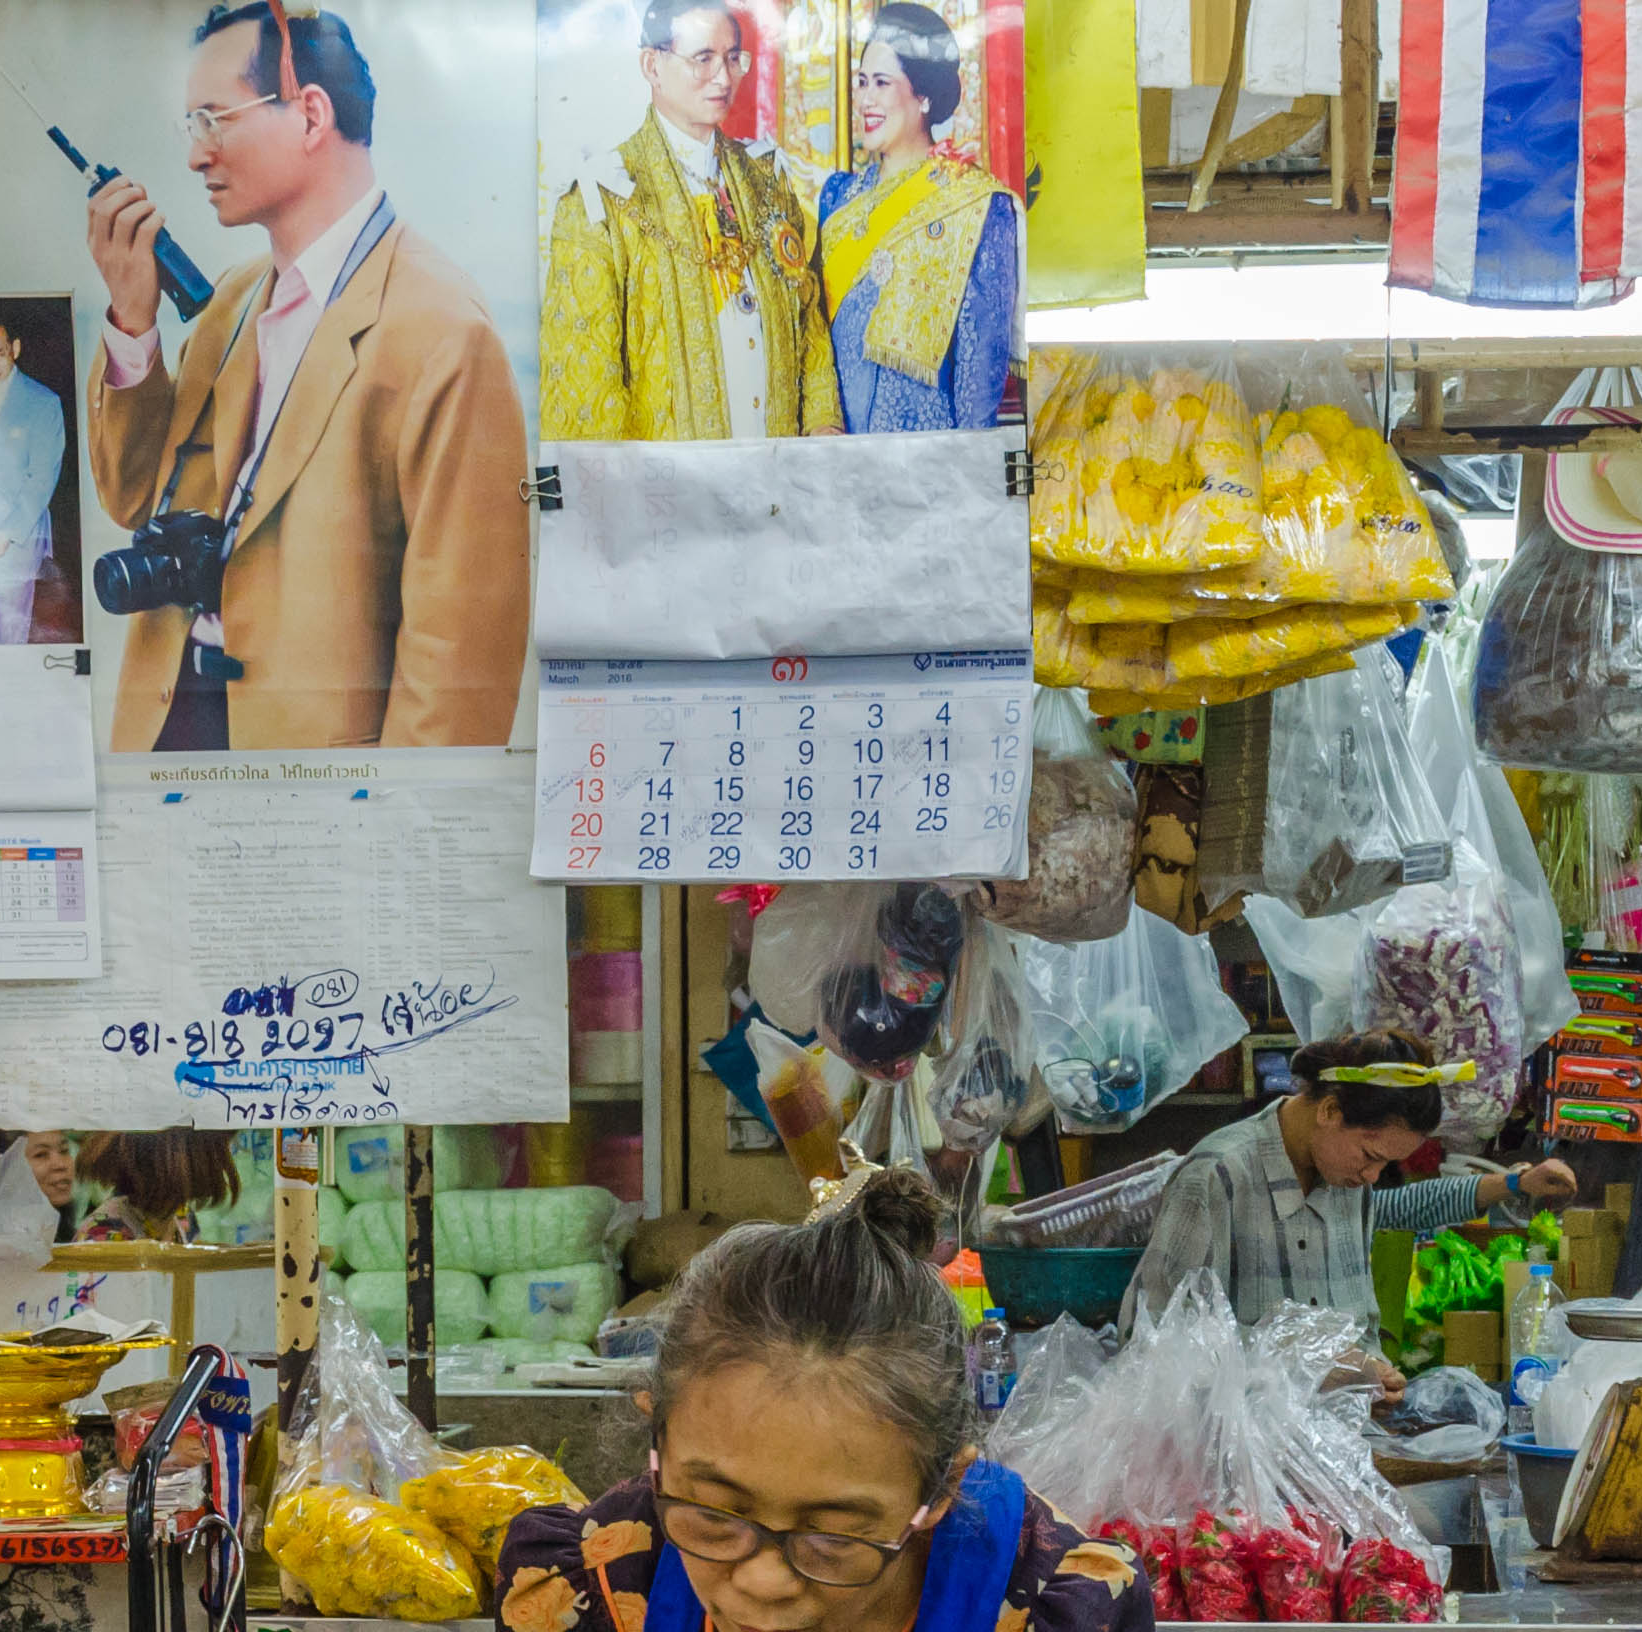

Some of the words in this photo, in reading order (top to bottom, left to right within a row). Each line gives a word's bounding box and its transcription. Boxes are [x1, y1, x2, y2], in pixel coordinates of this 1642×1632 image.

[548, 674, 579, 685] March
[607, 673, 633, 684] 2016
[771, 656, 808, 682] ๓
[731, 706, 741, 730] 1
[799, 705, 815, 730] 2
[867, 703, 884, 729] 3
[935, 701, 952, 726] 4
[1005, 700, 1021, 724] 5
[589, 743, 606, 768] 6
[659, 742, 676, 766] 7
[728, 741, 745, 766] 8
[798, 740, 814, 765] 9
[853, 738, 884, 764] 10
[923, 736, 949, 761] 11
[991, 735, 1020, 759] 12
[574, 778, 604, 803] 13
[644, 777, 674, 801] 14
[714, 777, 744, 802] 15
[783, 776, 813, 801] 16
[853, 774, 883, 799] 17
[922, 773, 950, 797] 18
[990, 770, 1016, 795] 19
[570, 812, 603, 837] 20
[639, 811, 669, 836] 21
[709, 811, 743, 836] 22
[780, 811, 813, 836] 23
[850, 809, 882, 835] 24
[915, 807, 948, 831] 25
[983, 804, 1012, 830] 26
[567, 846, 602, 869] 27
[638, 846, 671, 870] 28
[707, 846, 741, 870] 29
[778, 846, 811, 870] 30
[848, 844, 877, 870] 31
[311, 979, 347, 1001] 081
